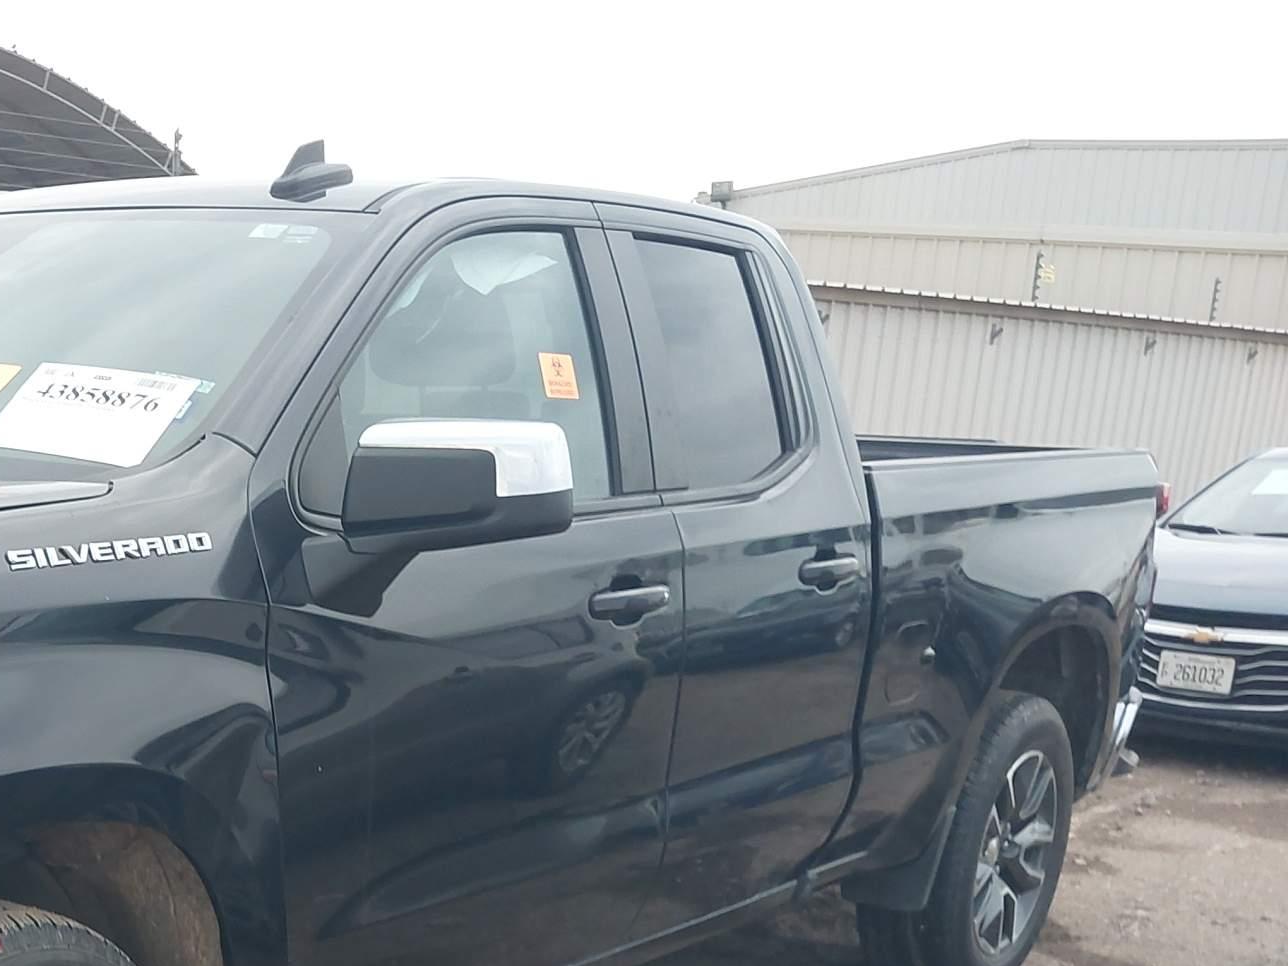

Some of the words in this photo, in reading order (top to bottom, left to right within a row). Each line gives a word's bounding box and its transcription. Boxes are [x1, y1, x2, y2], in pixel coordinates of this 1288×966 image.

[37, 383, 160, 412] 43858876
[5, 532, 212, 571] SILVERADO
[1173, 663, 1225, 687] 261032
